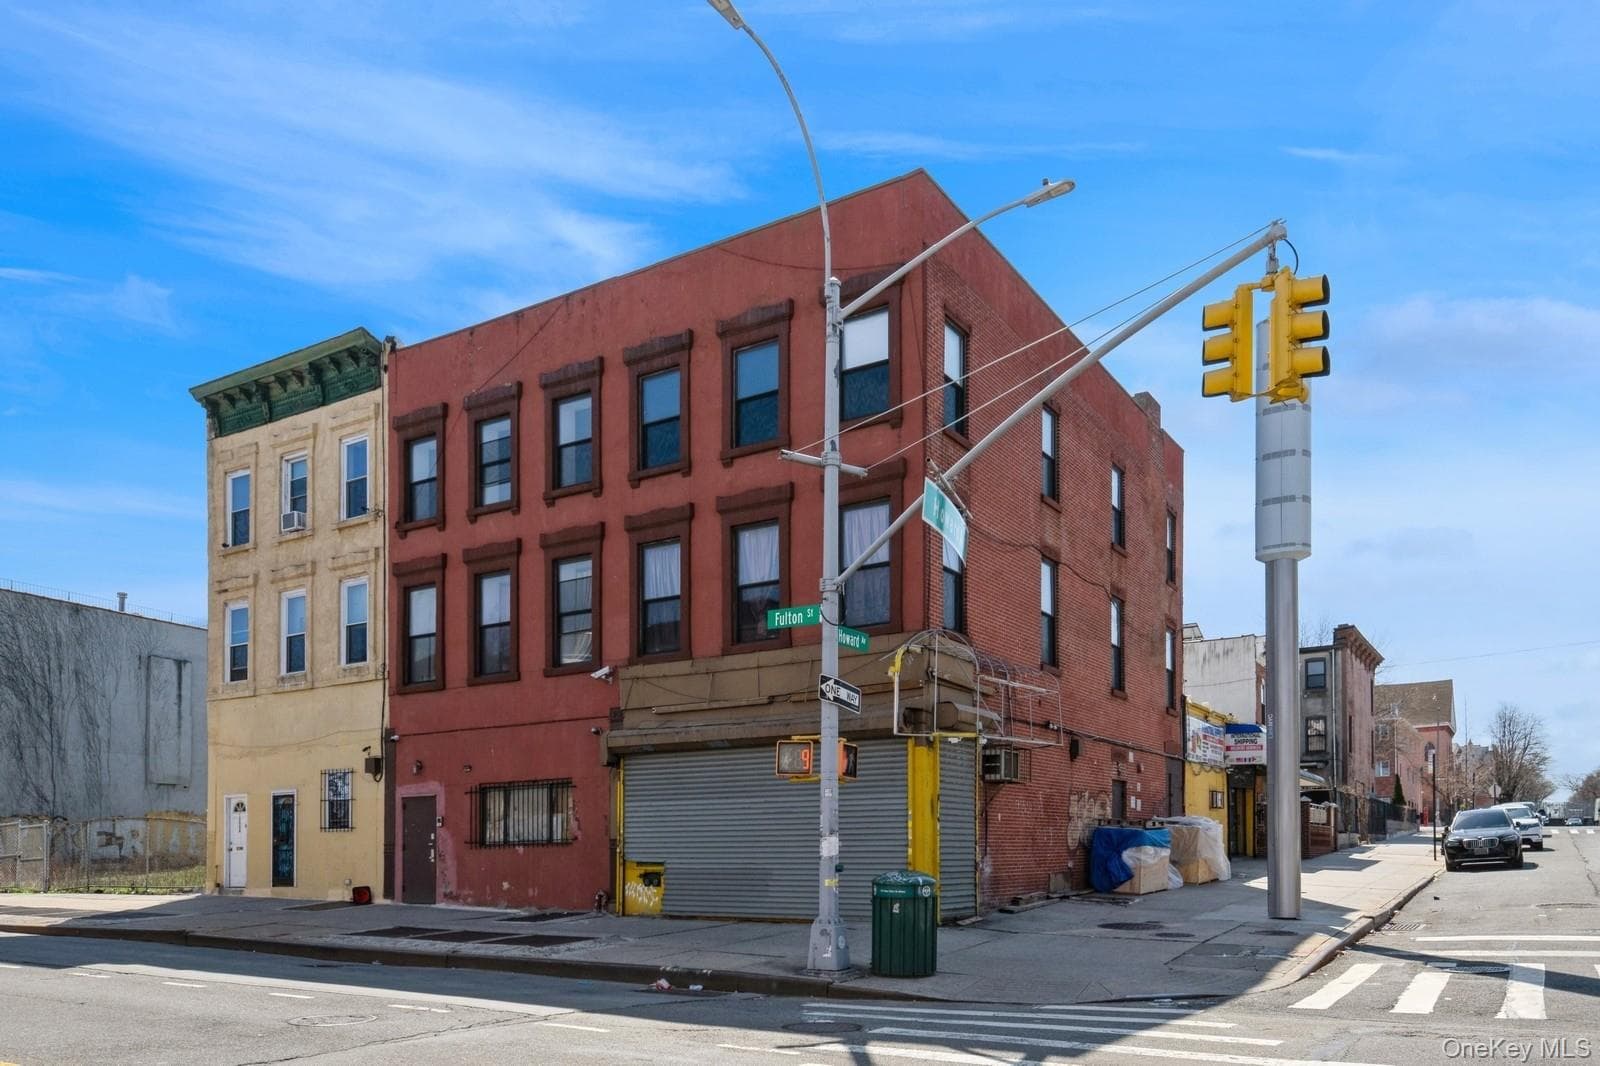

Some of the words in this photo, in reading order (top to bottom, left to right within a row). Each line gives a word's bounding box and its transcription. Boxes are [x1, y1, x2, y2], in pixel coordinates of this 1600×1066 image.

[775, 612, 803, 626] Fulton
[807, 608, 814, 618] St
[838, 630, 860, 648] Howard
[824, 686, 841, 697] ONE
[846, 692, 858, 703] WAY
[801, 749, 809, 769] 9
